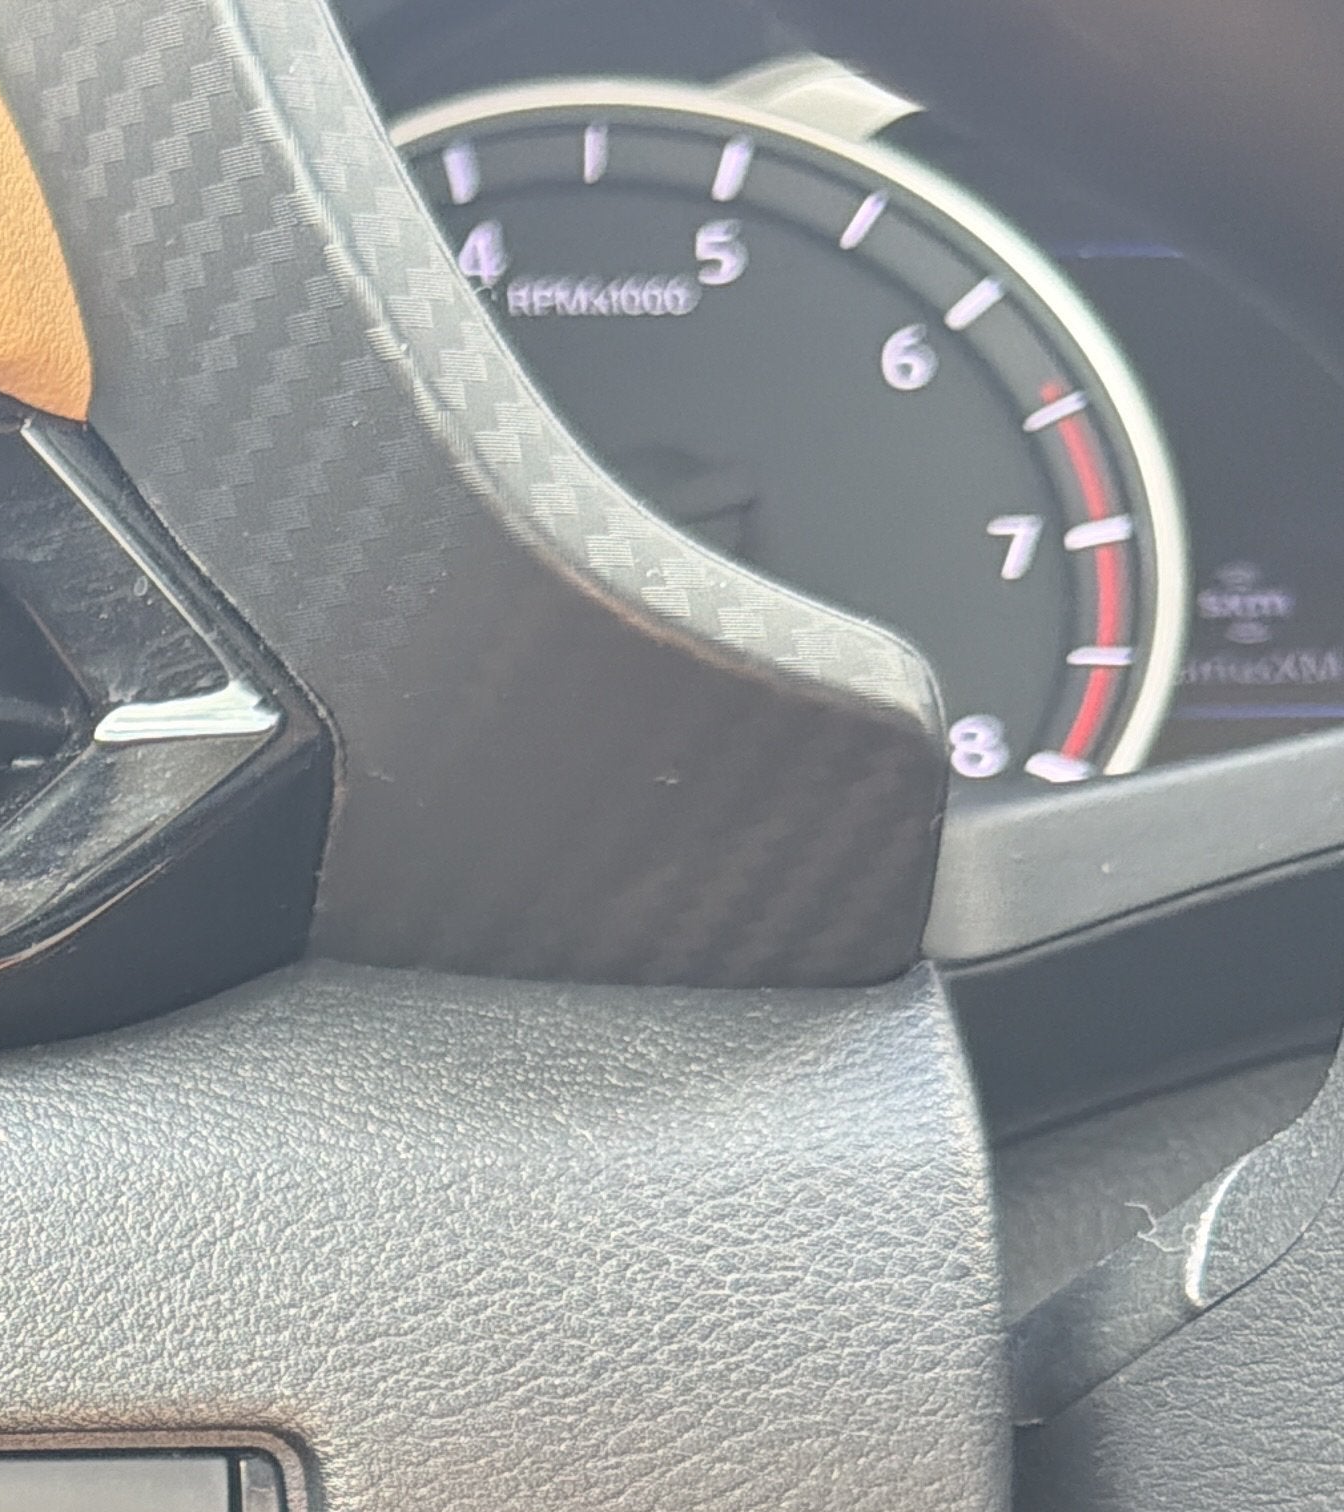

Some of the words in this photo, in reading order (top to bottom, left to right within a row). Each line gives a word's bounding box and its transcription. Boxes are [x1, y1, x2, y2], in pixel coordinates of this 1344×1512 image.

[460, 219, 507, 286] 4
[695, 219, 748, 285] 5
[880, 324, 938, 390] 6
[987, 514, 1042, 579] 7
[950, 714, 1010, 779] 8
